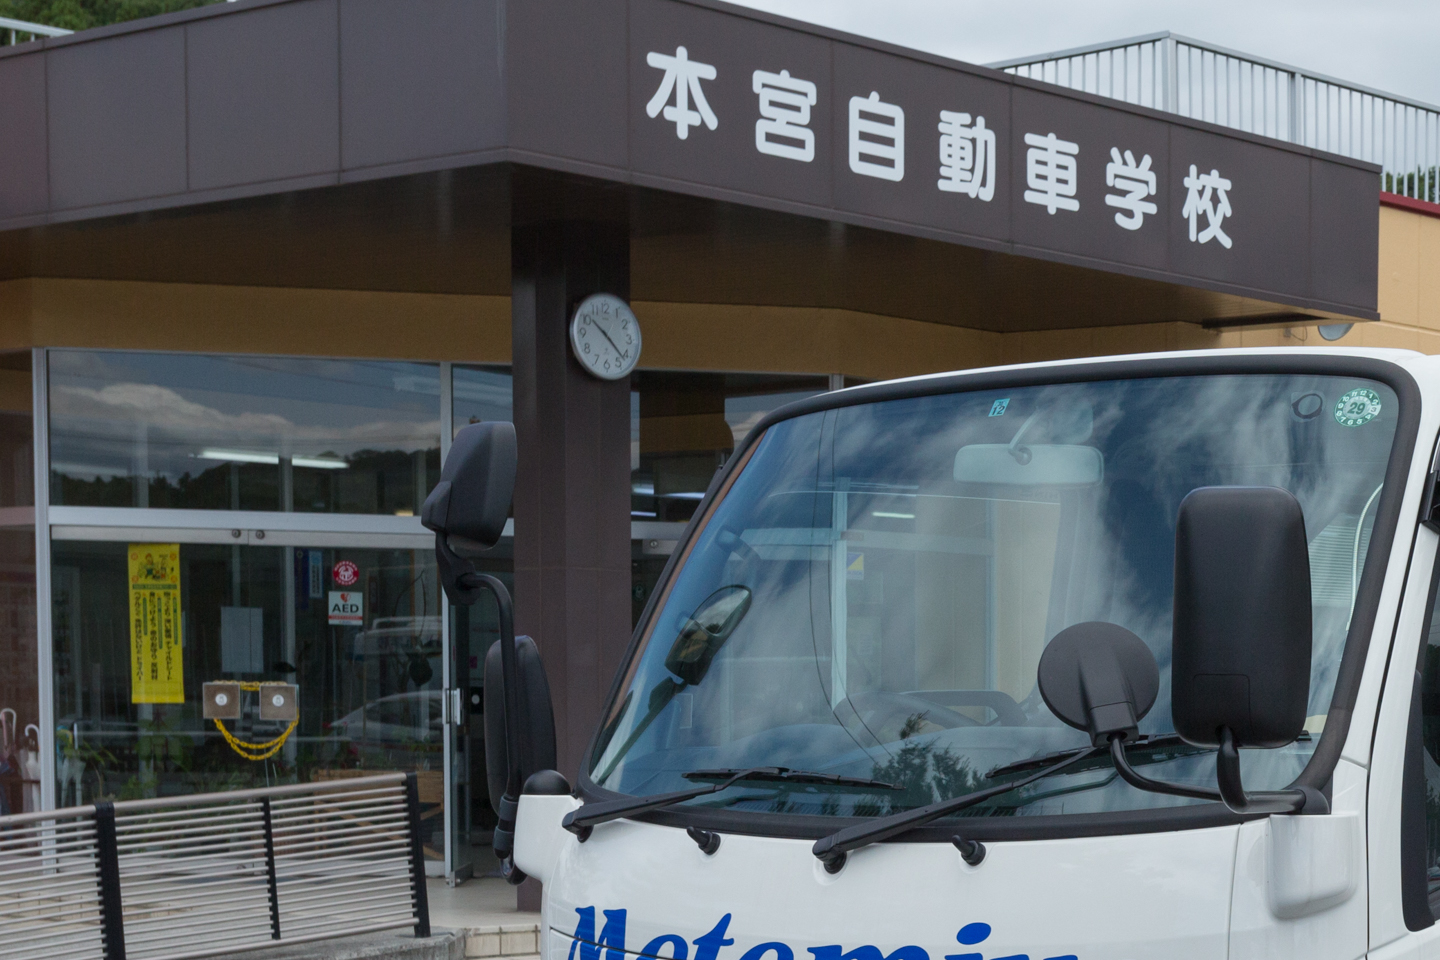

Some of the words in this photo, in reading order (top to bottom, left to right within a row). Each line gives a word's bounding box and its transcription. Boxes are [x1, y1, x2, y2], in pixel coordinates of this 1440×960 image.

[645, 44, 1234, 250] 本宮自動車学校
[592, 304, 598, 315] 11
[602, 303, 610, 314] 12
[584, 314, 592, 326] 10
[621, 318, 628, 330] 2
[580, 328, 586, 338] 9
[626, 334, 632, 344] 3
[584, 343, 591, 354] 8
[594, 354, 600, 365] 7
[603, 359, 611, 370] 6
[615, 357, 622, 368] 5
[991, 405, 1006, 416] 12
[1347, 401, 1366, 415] 29
[331, 603, 360, 614] AED
